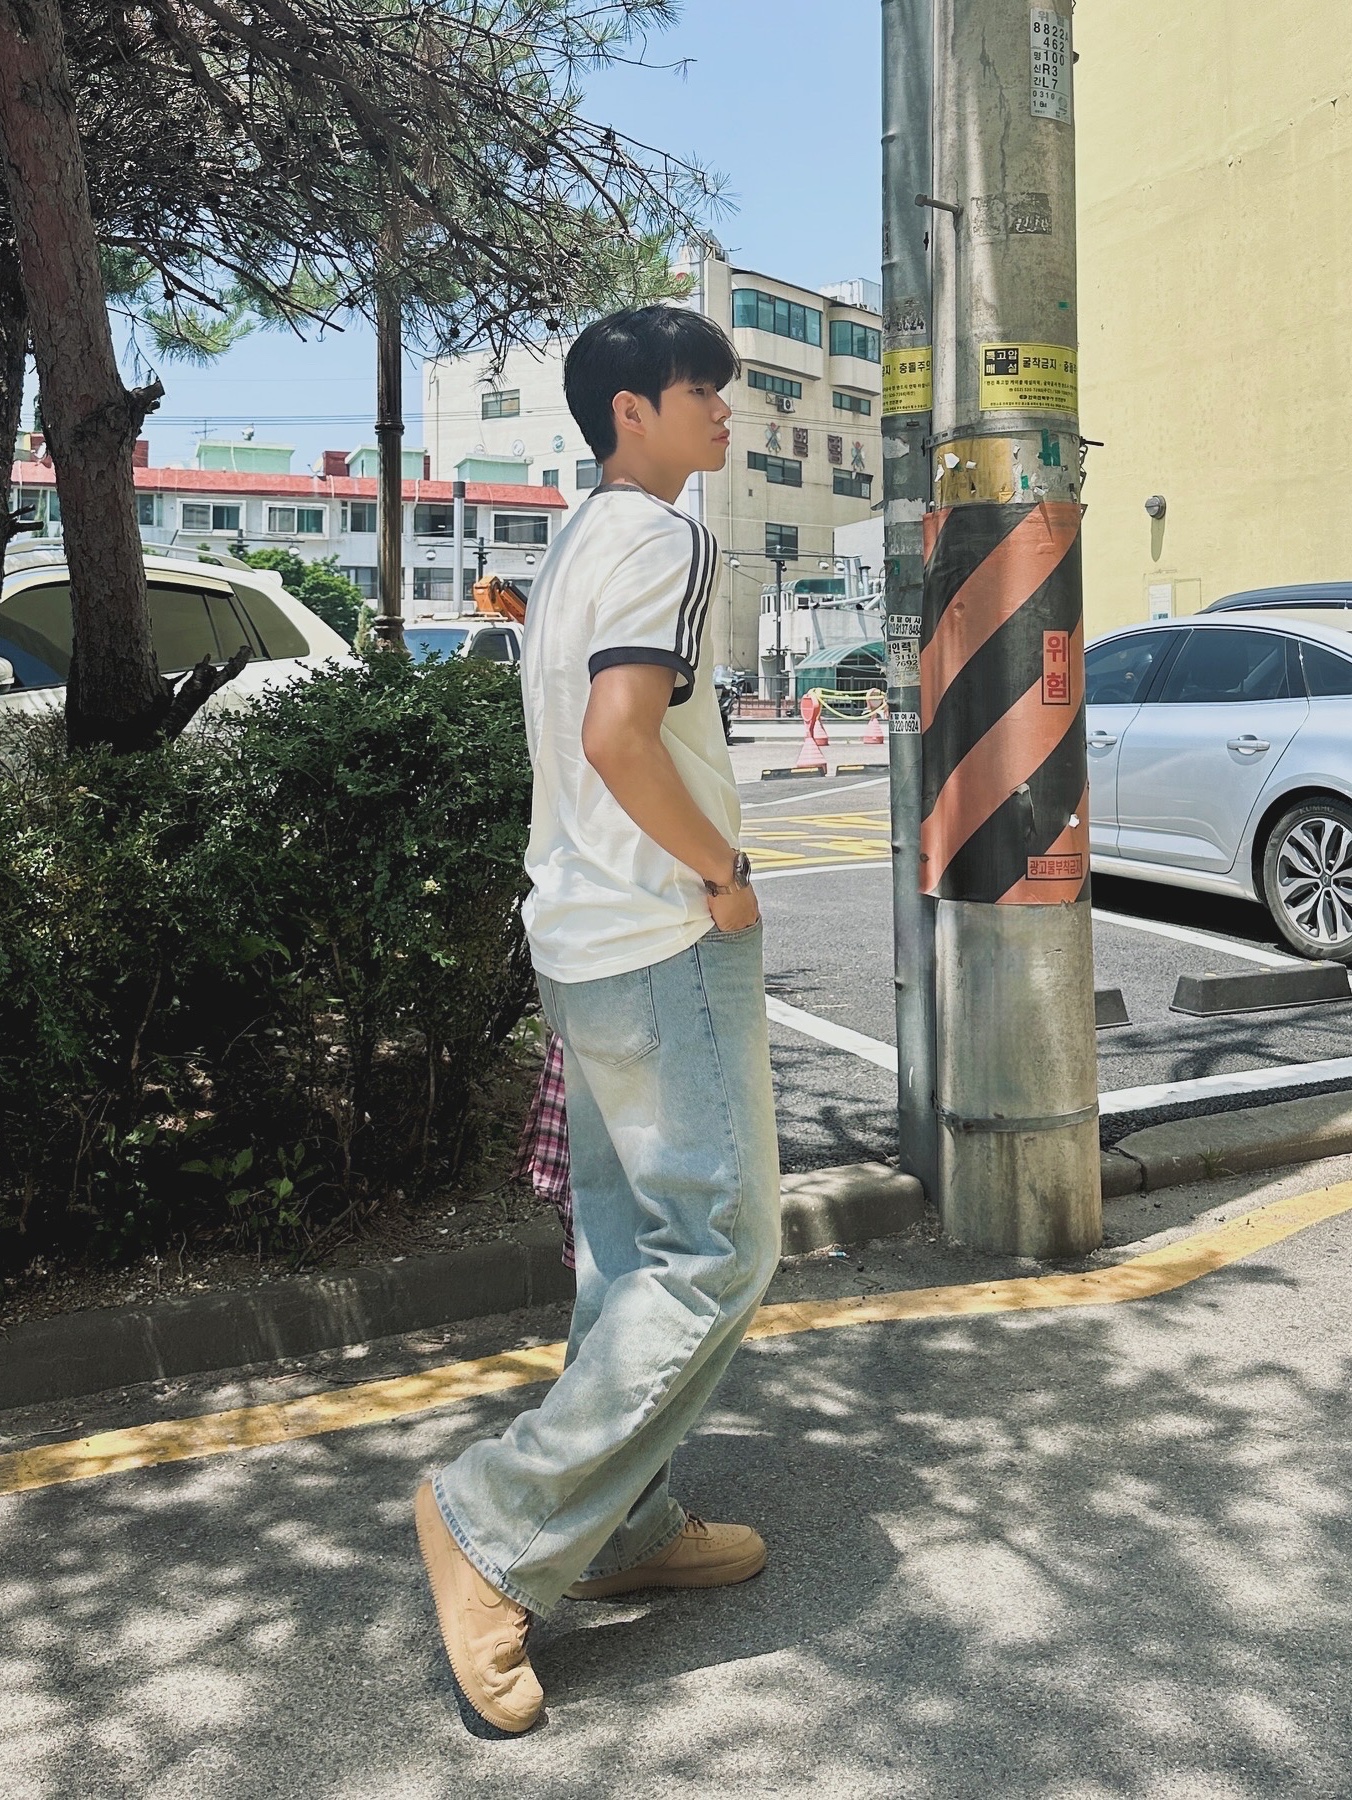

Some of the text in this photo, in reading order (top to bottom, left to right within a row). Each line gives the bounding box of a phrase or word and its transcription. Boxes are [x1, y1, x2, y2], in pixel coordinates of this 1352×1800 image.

[1044, 37, 1064, 52] 462
[1023, 357, 1057, 370] 굴착금지
[1046, 636, 1067, 698] 위험
[1300, 805, 1335, 815] KUMHO
